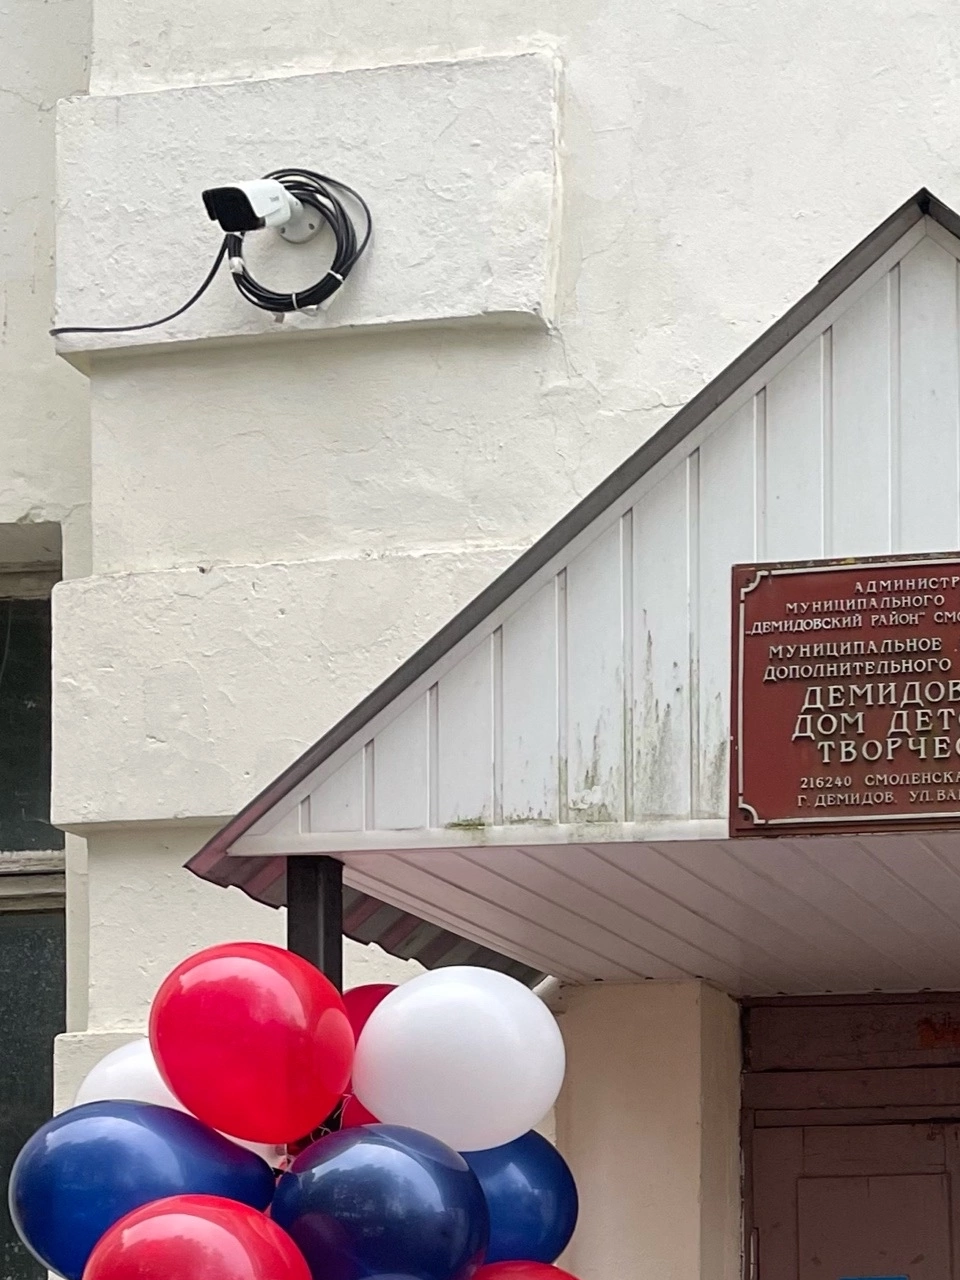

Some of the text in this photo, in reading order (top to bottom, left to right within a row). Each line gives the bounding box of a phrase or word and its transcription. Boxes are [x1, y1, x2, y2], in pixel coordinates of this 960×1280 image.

[786, 594, 945, 614] МУНИЦИПАЛЬНОГО
[769, 638, 942, 659] МУНИЦИПАЛЬНОЕ
[763, 658, 952, 682] ДОПОЛНИТЕЛЬНОГО
[792, 713, 864, 741] ДОМ
[801, 775, 852, 788] 216240
